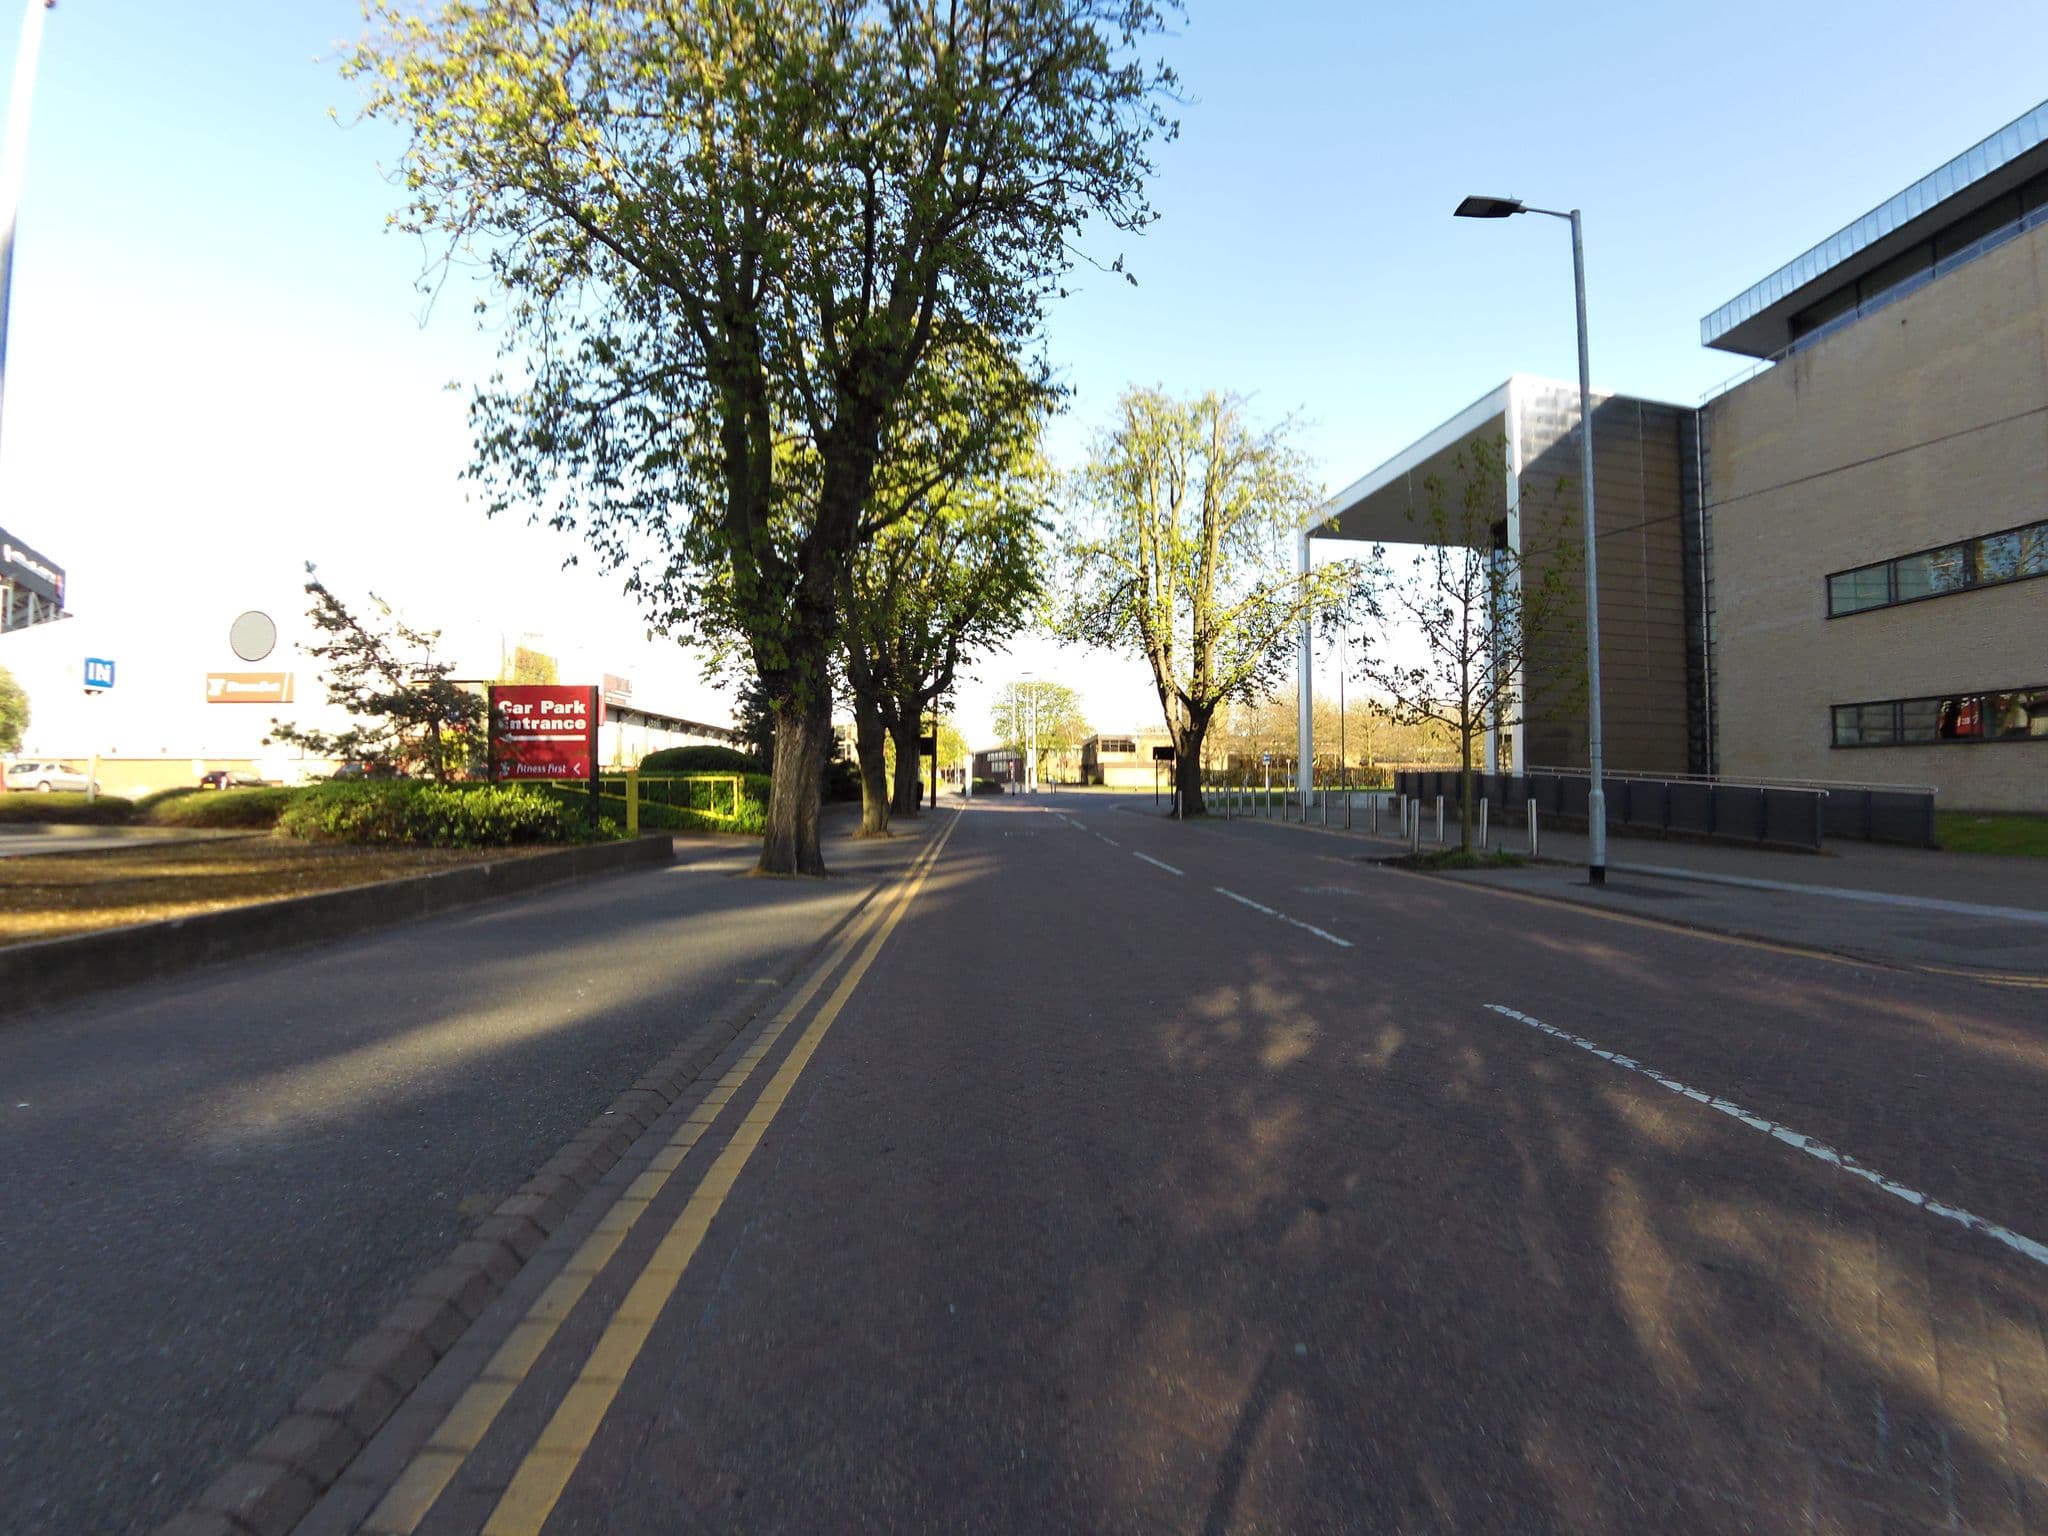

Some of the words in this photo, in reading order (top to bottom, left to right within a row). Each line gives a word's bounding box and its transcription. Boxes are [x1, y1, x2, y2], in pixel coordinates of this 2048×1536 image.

[88, 662, 111, 683] IN
[498, 700, 533, 715] Car
[541, 700, 586, 715] Park
